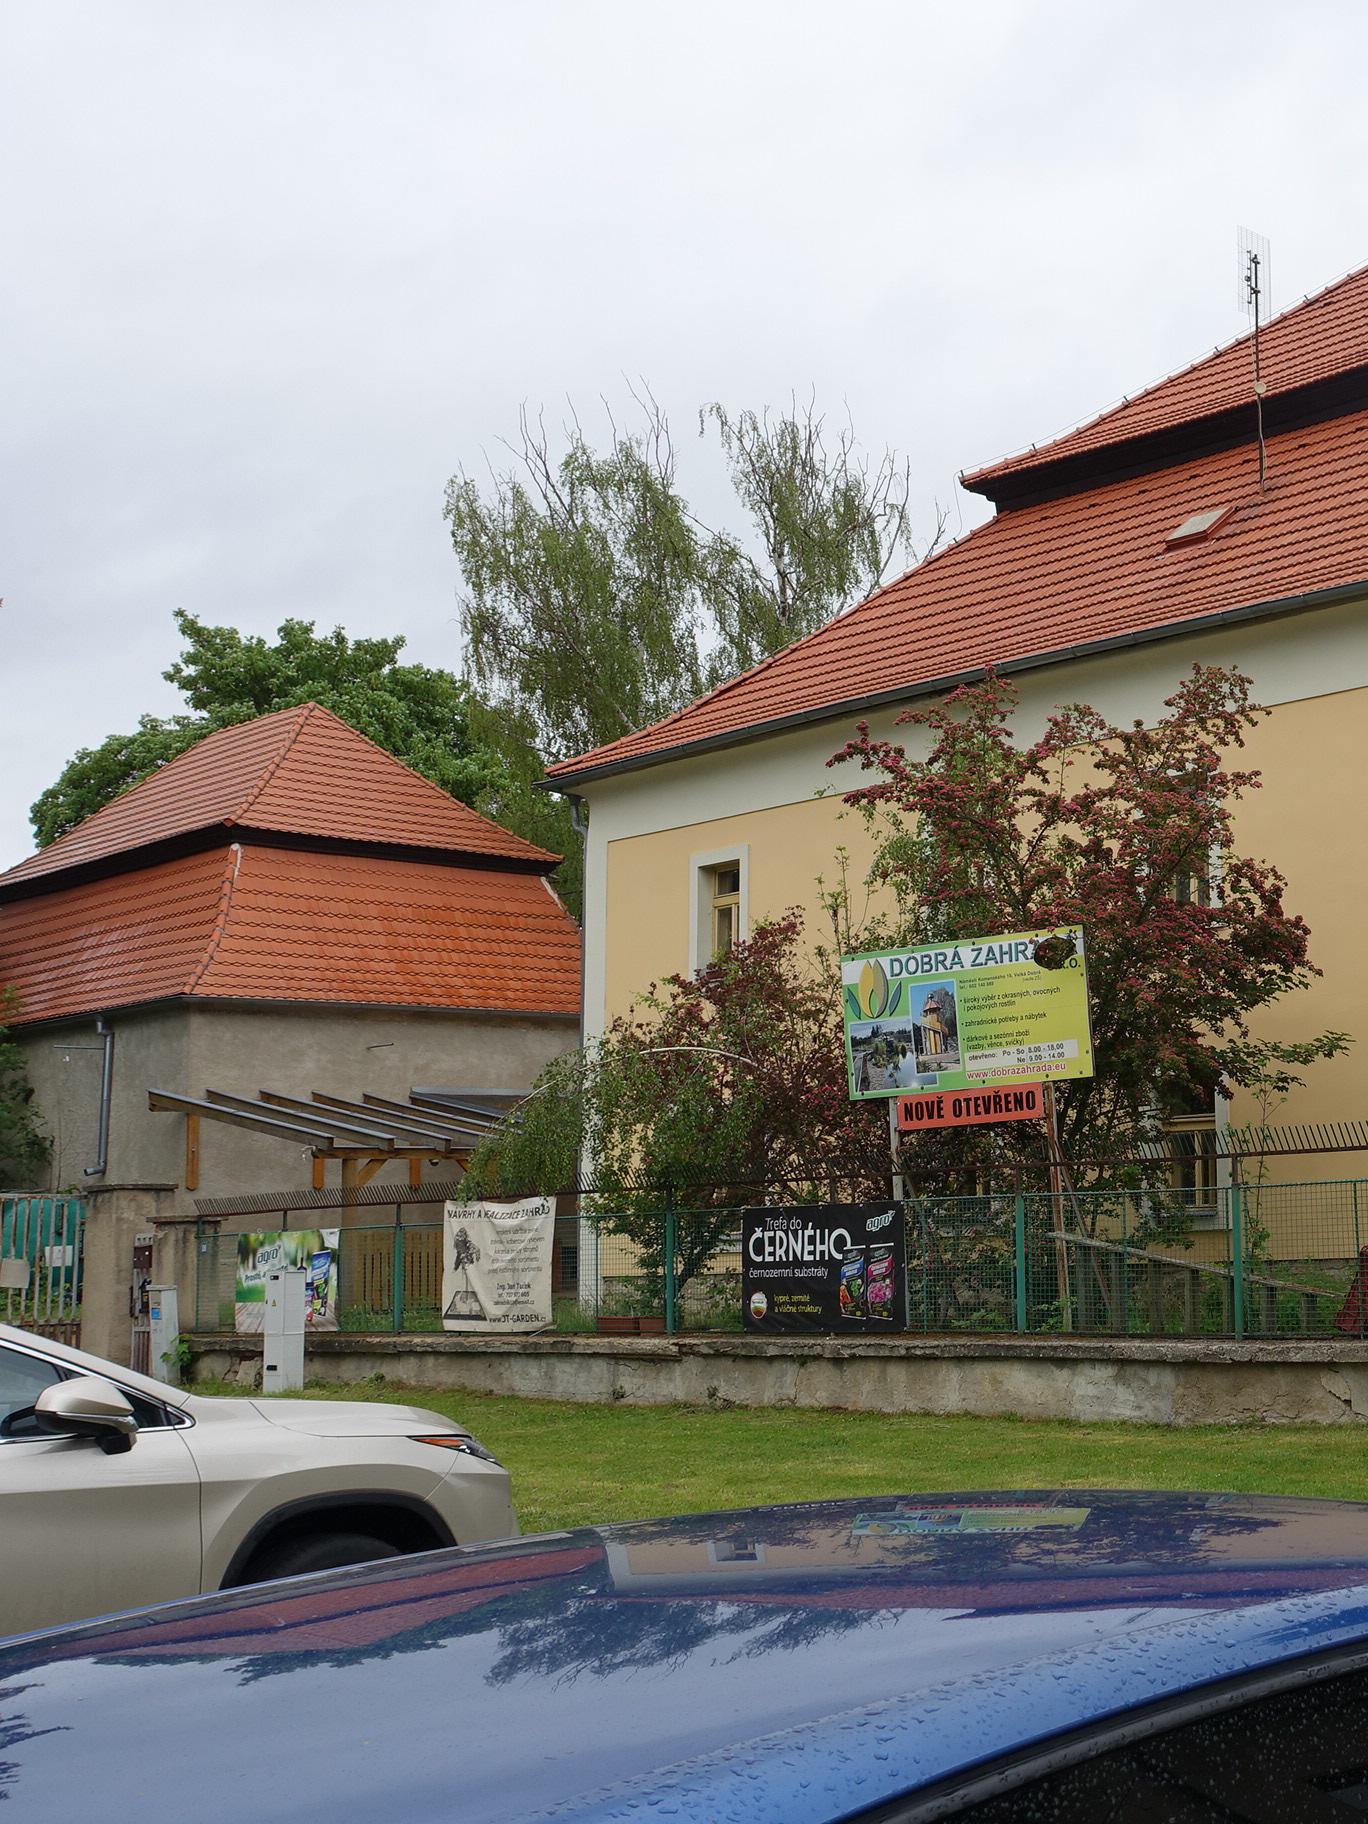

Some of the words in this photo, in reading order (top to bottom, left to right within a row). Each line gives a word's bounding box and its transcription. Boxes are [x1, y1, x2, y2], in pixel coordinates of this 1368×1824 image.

[889, 945, 965, 977] DOBRÁ
[1032, 986, 1061, 996] ovocných
[966, 1001, 998, 1012] pokojových
[1016, 1047, 1025, 1055] So
[1028, 1054, 1043, 1062] 9.00
[1048, 1051, 1065, 1060] 14.00
[967, 1062, 1066, 1080] www.dobrazahrada.eu
[903, 1095, 944, 1122] NOVĚ
[952, 1090, 1036, 1118] OTEVŘENO
[477, 1209, 482, 1218] A
[765, 1216, 788, 1231] Trefa
[789, 1216, 802, 1230] do
[866, 1212, 895, 1232] agro
[748, 1222, 852, 1263] ČERNÉHO
[749, 1266, 793, 1278] černozemní
[794, 1265, 829, 1279] substráty
